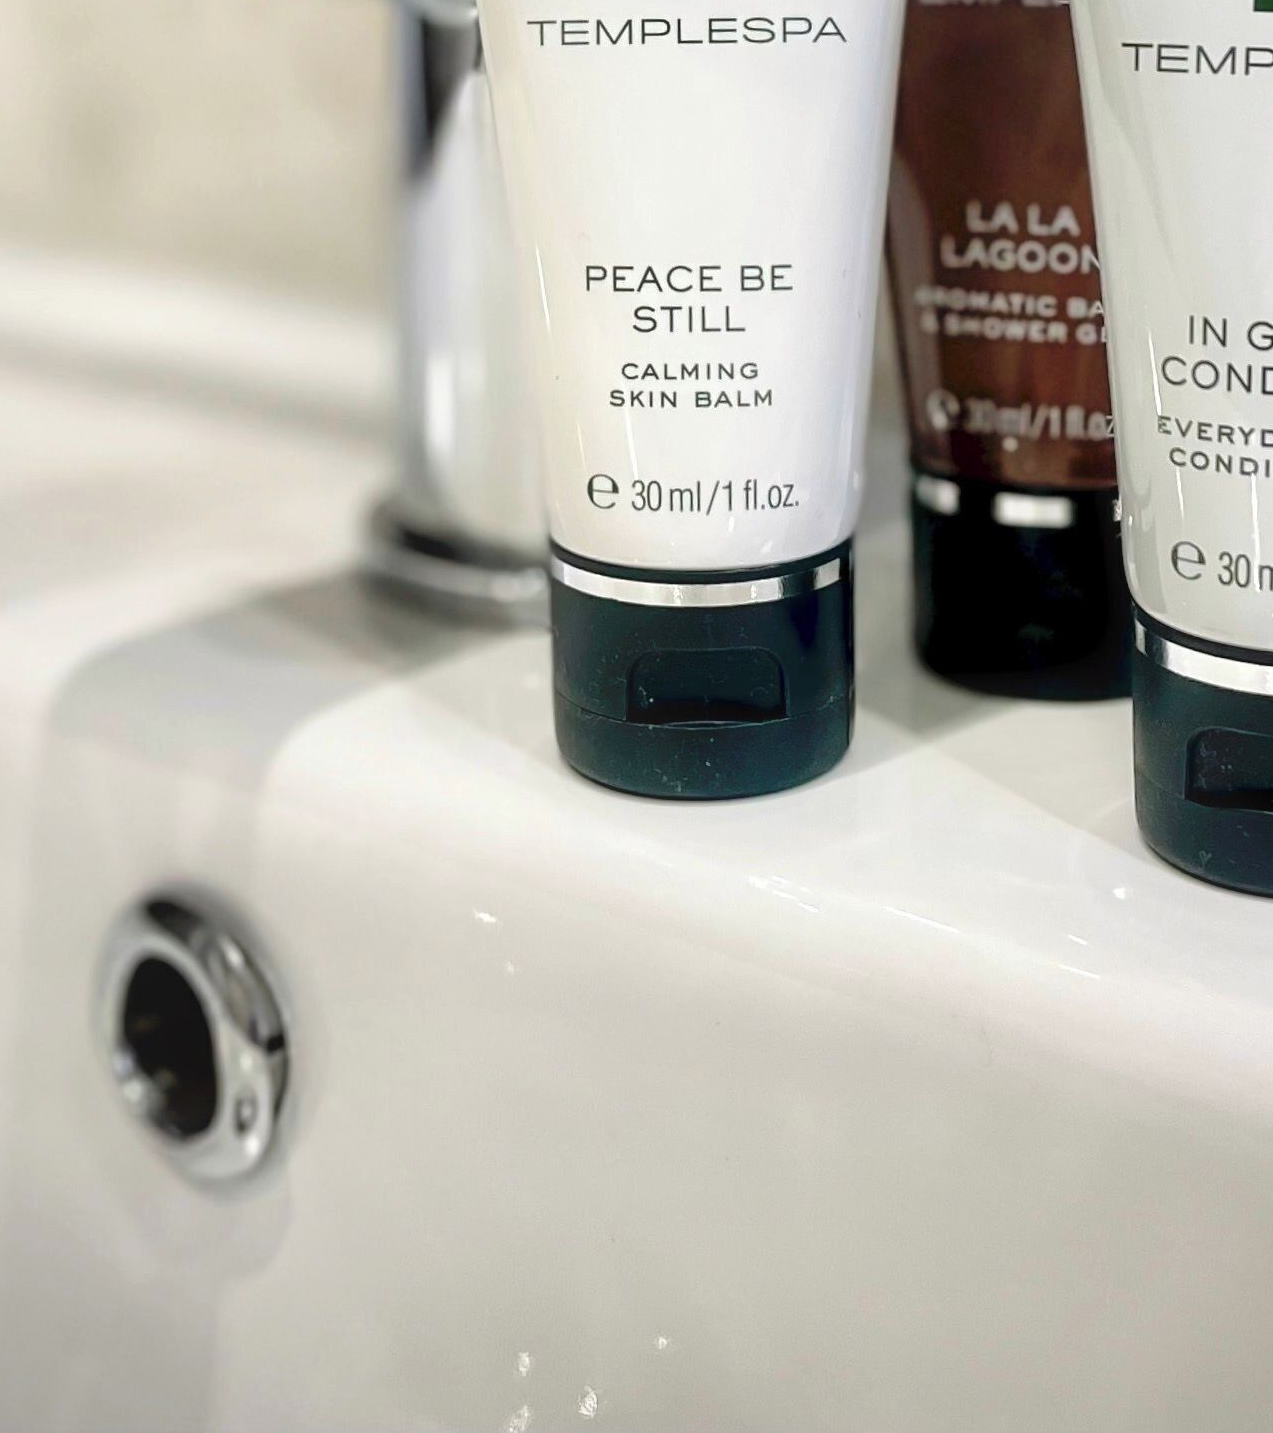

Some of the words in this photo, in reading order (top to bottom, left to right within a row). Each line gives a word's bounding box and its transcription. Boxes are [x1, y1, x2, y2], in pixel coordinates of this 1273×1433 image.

[527, 17, 847, 46] TEMPLESPA
[966, 200, 1018, 234] LA
[1027, 203, 1080, 236] LA
[586, 265, 722, 292] PEACE
[740, 264, 793, 292] BE
[632, 305, 746, 333] STILL
[1189, 315, 1227, 348] IN
[621, 362, 759, 380] CALMING
[609, 389, 677, 408] SKIN
[695, 389, 772, 408] BALM
